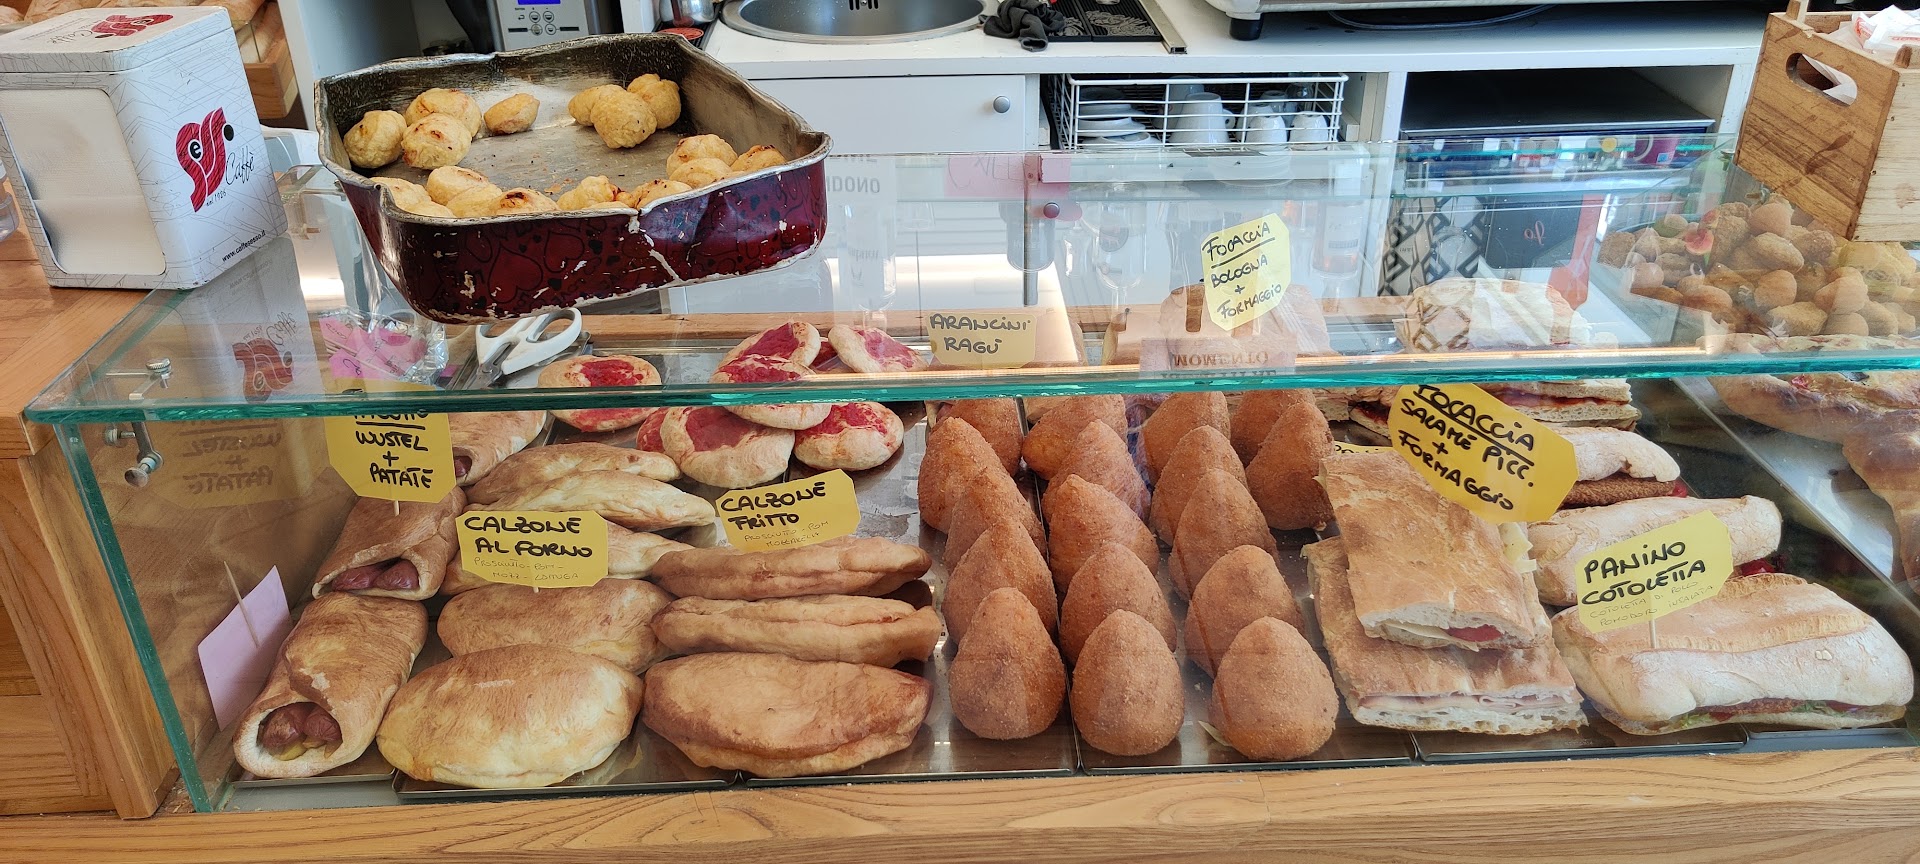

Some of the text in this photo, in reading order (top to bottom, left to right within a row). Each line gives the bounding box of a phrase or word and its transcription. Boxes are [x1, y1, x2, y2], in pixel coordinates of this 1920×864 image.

[226, 145, 254, 185] Caffè
[1202, 222, 1271, 261] FOCACCIA
[1210, 254, 1268, 288] BOLOGNA
[1217, 283, 1282, 318] FORMAGGIO
[1234, 284, 1246, 294] +
[930, 313, 1031, 330] ARANCINI
[1400, 398, 1478, 450] SALAME
[355, 430, 429, 451] WUSTEL
[1432, 441, 1448, 455] +
[383, 450, 399, 467] +
[1398, 429, 1514, 510] FORMAGGIO
[369, 462, 433, 488] PATATE
[721, 482, 826, 512] CALZONE
[464, 516, 582, 534] CALZONE
[728, 513, 800, 530] FRITTO
[475, 537, 593, 558] AL FORNO
[1584, 541, 1686, 583] PANINO
[1581, 559, 1706, 605] COTOLETTA
